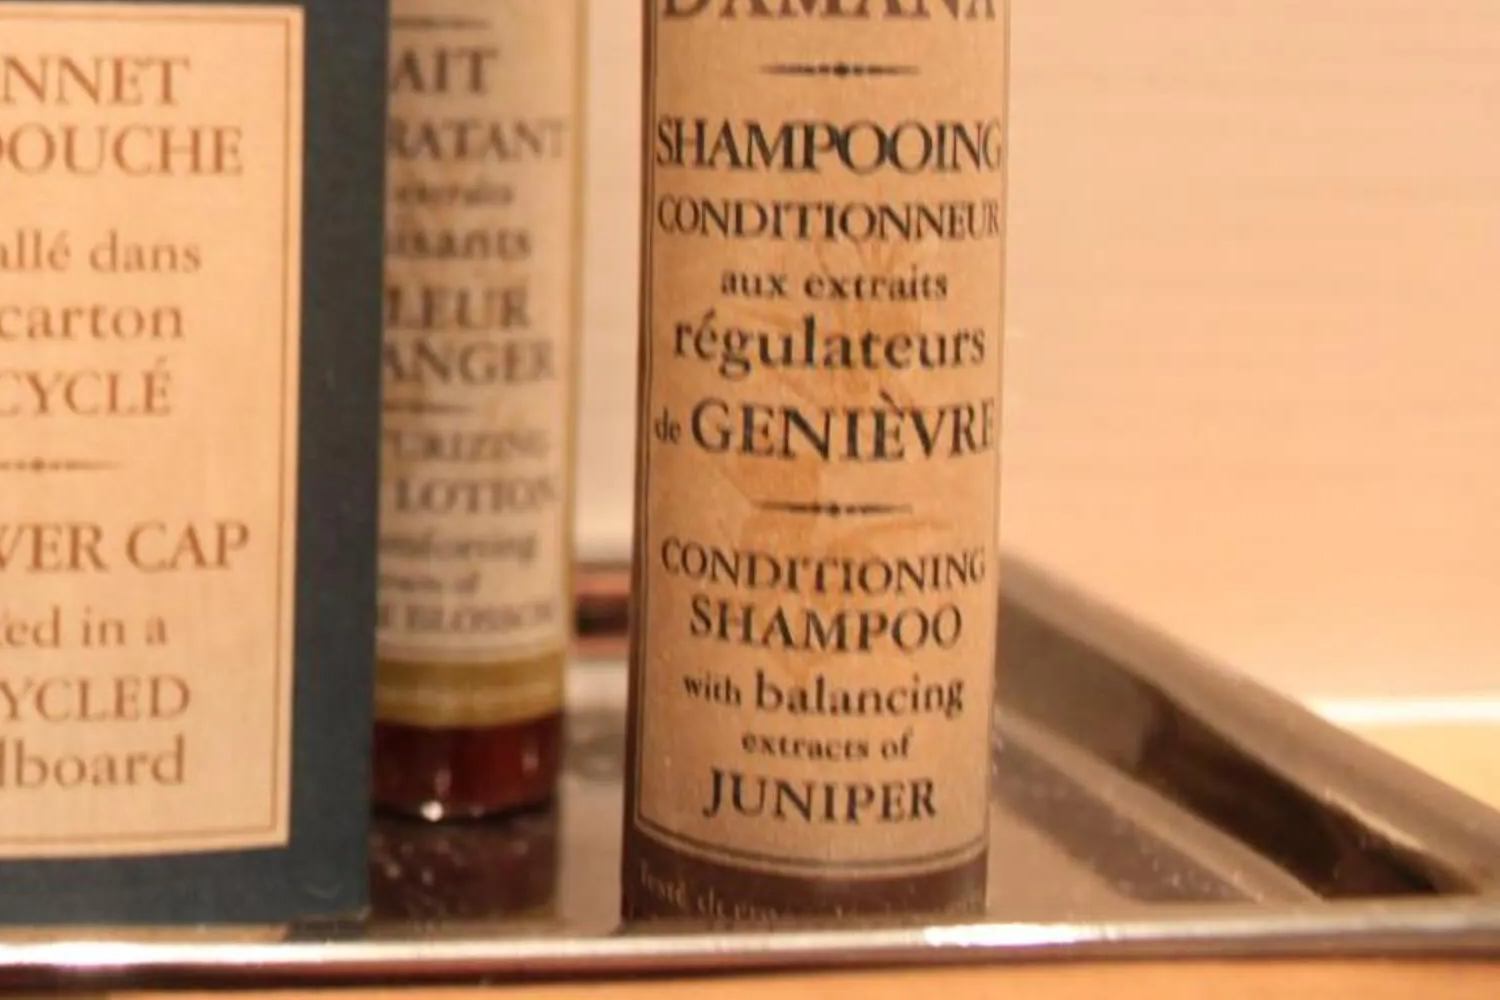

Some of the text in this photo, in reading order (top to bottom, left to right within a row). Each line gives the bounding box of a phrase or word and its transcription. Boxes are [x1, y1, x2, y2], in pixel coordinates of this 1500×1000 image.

[389, 46, 500, 94] AIT
[389, 118, 566, 162] RATANT
[656, 117, 1002, 176] SHAMPOOING
[656, 193, 1000, 242] CONDITIONNEUR
[89, 230, 202, 273] dans
[720, 262, 950, 300] aux extraits
[386, 284, 532, 332] LEUR
[383, 338, 556, 386] ANGER
[673, 308, 988, 379] régulateurs
[654, 389, 995, 464] de GENIÈVRE
[124, 521, 250, 574] CAP
[660, 536, 987, 597] CONDITIONING
[81, 606, 129, 647] in
[145, 616, 169, 647] a
[689, 595, 963, 655] SHAMPOO
[682, 668, 965, 719] with balancing
[741, 726, 912, 761] extracts of
[702, 767, 938, 825] JUNIPER
